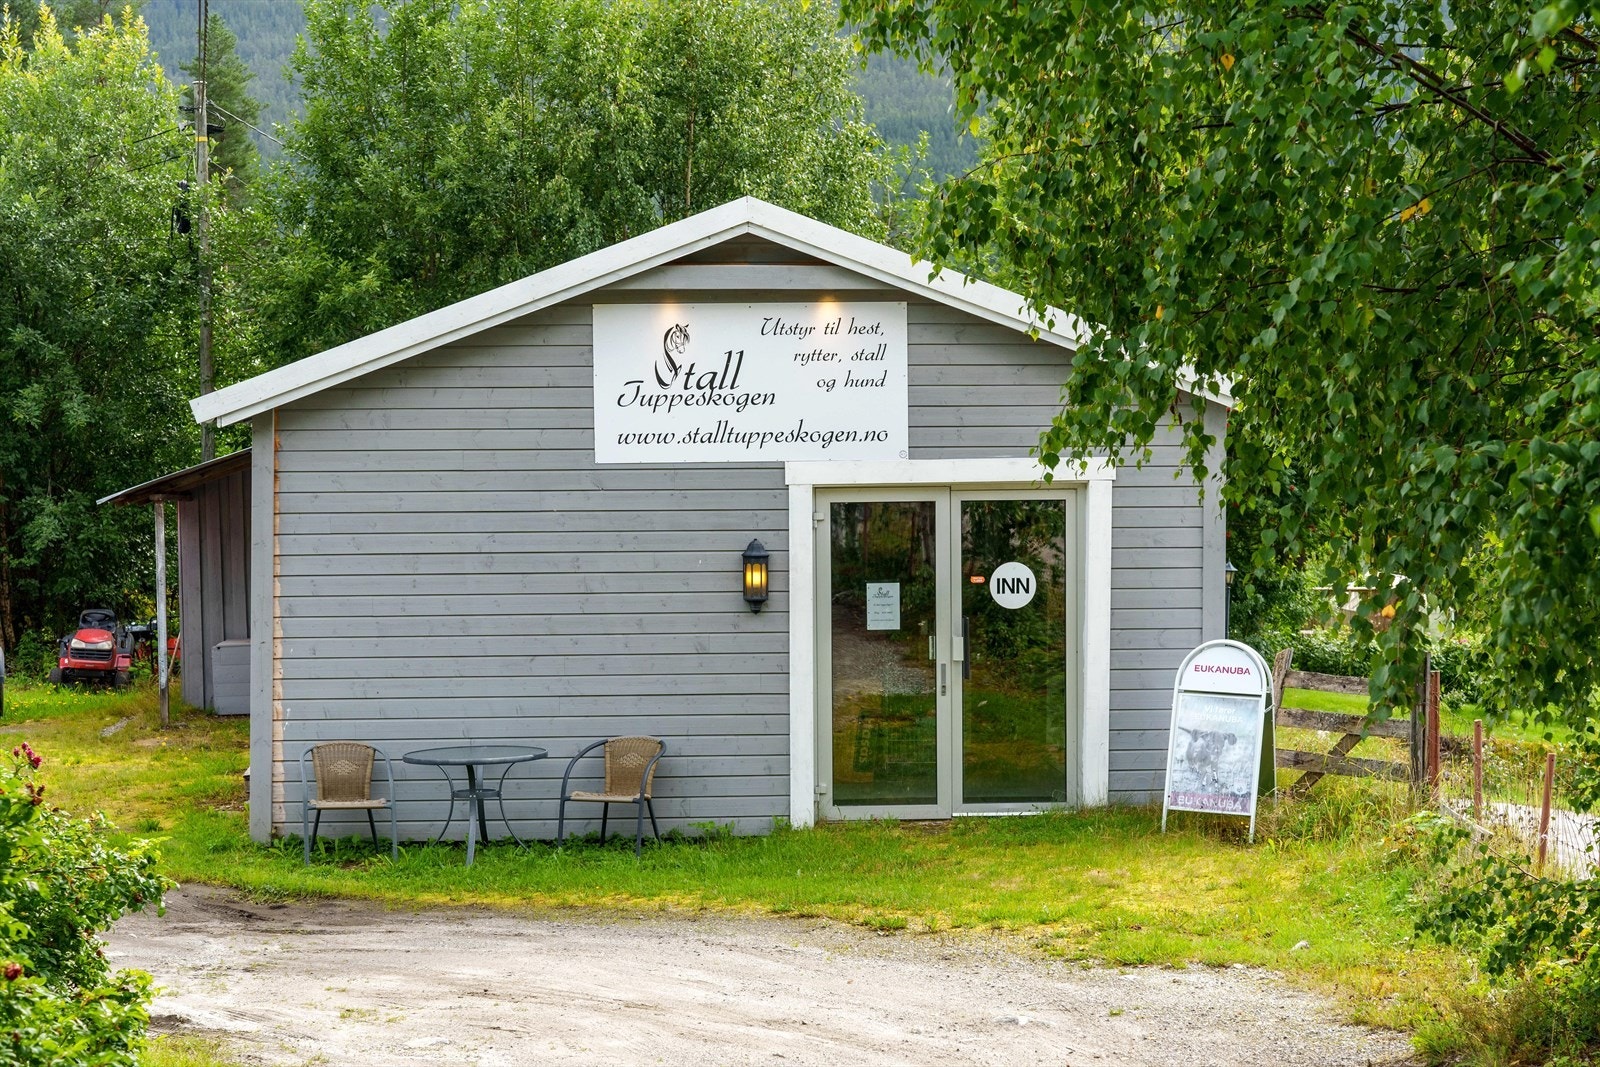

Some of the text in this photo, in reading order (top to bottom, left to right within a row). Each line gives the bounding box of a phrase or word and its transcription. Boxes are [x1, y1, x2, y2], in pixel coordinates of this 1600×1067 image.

[760, 317, 885, 340] Utstyr til hest,
[654, 323, 745, 391] Stall
[793, 343, 887, 366] rytter, stall
[816, 369, 888, 393] og hund
[616, 380, 776, 414] Tuppeskogen
[617, 419, 889, 450] www.stalltuppeskogen.no
[996, 577, 1030, 595] INN
[1194, 664, 1251, 676] EUKANUBA
[1177, 795, 1243, 811] EUKANUBA
